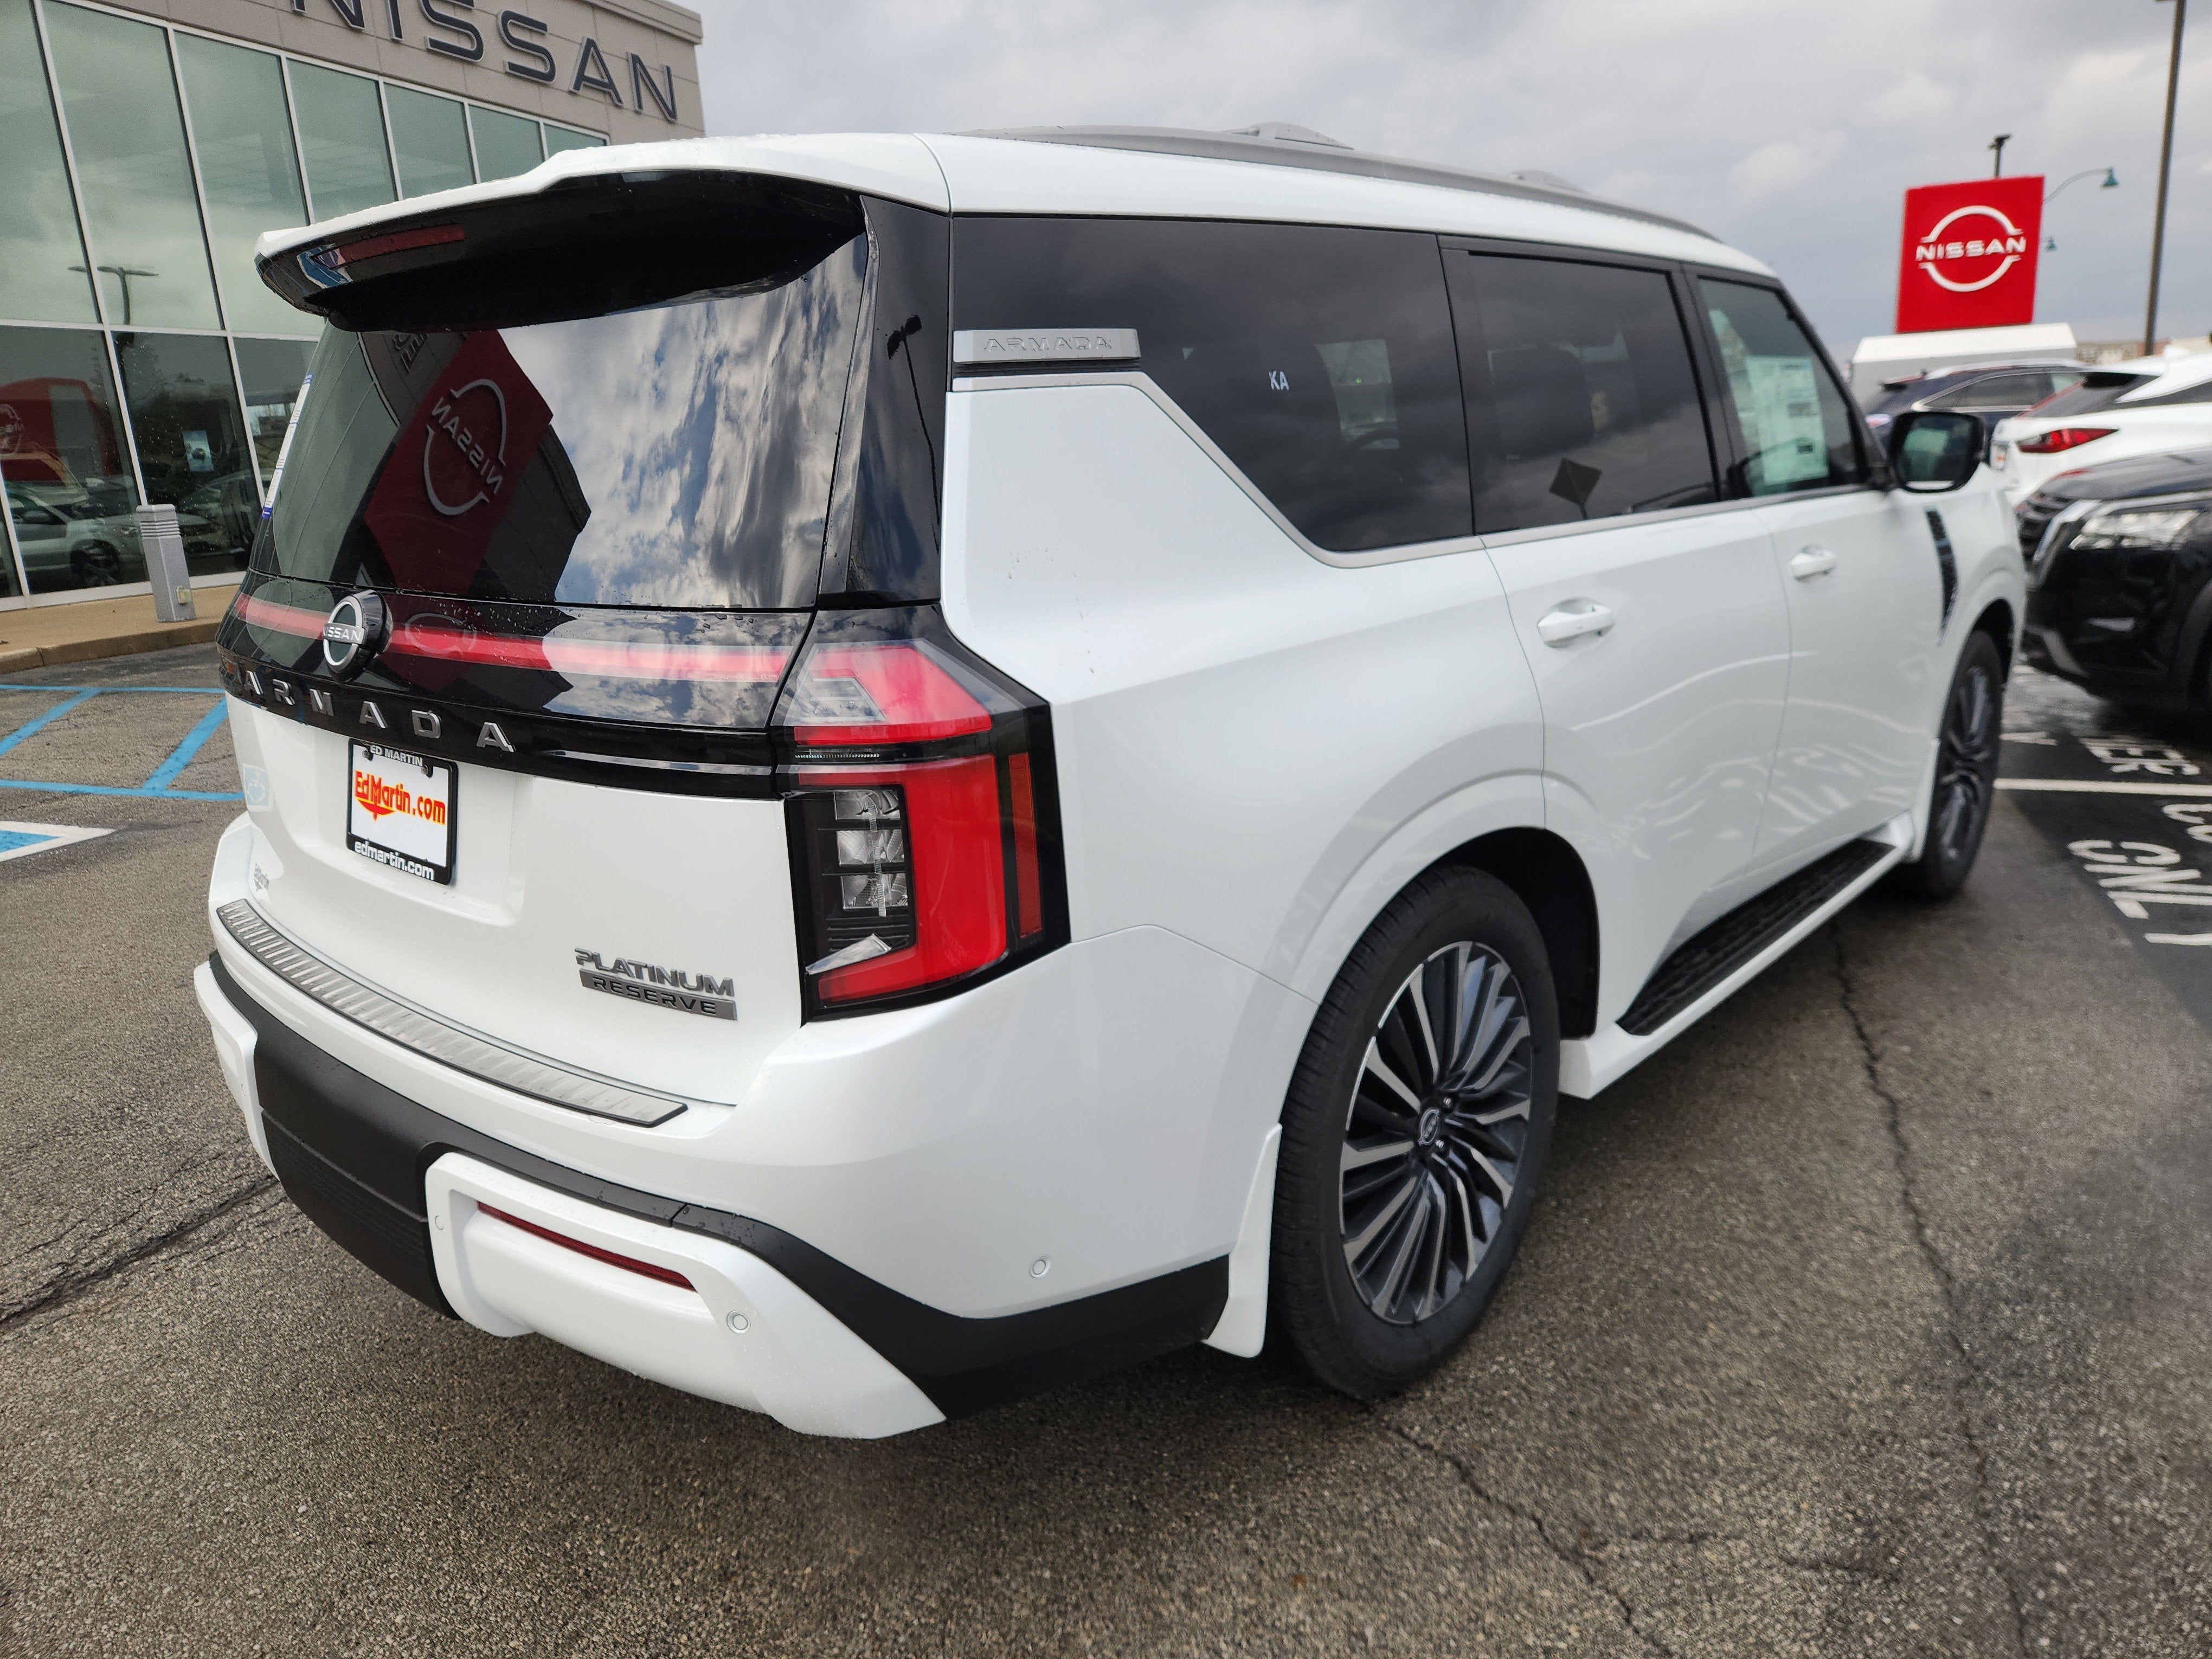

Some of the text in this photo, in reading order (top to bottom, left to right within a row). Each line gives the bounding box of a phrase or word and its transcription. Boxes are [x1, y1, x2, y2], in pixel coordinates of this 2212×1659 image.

[1916, 236, 2026, 261] NISSAN
[984, 337, 1112, 352] ARMADA
[1269, 370, 1290, 390] KA
[324, 625, 362, 641] ISSAN
[243, 670, 517, 753] ARMADA
[370, 744, 423, 766] ED MARTIN
[355, 841, 434, 880] edmartin.com
[575, 947, 735, 997] PLATINUM
[593, 976, 717, 1016] RESERVE
